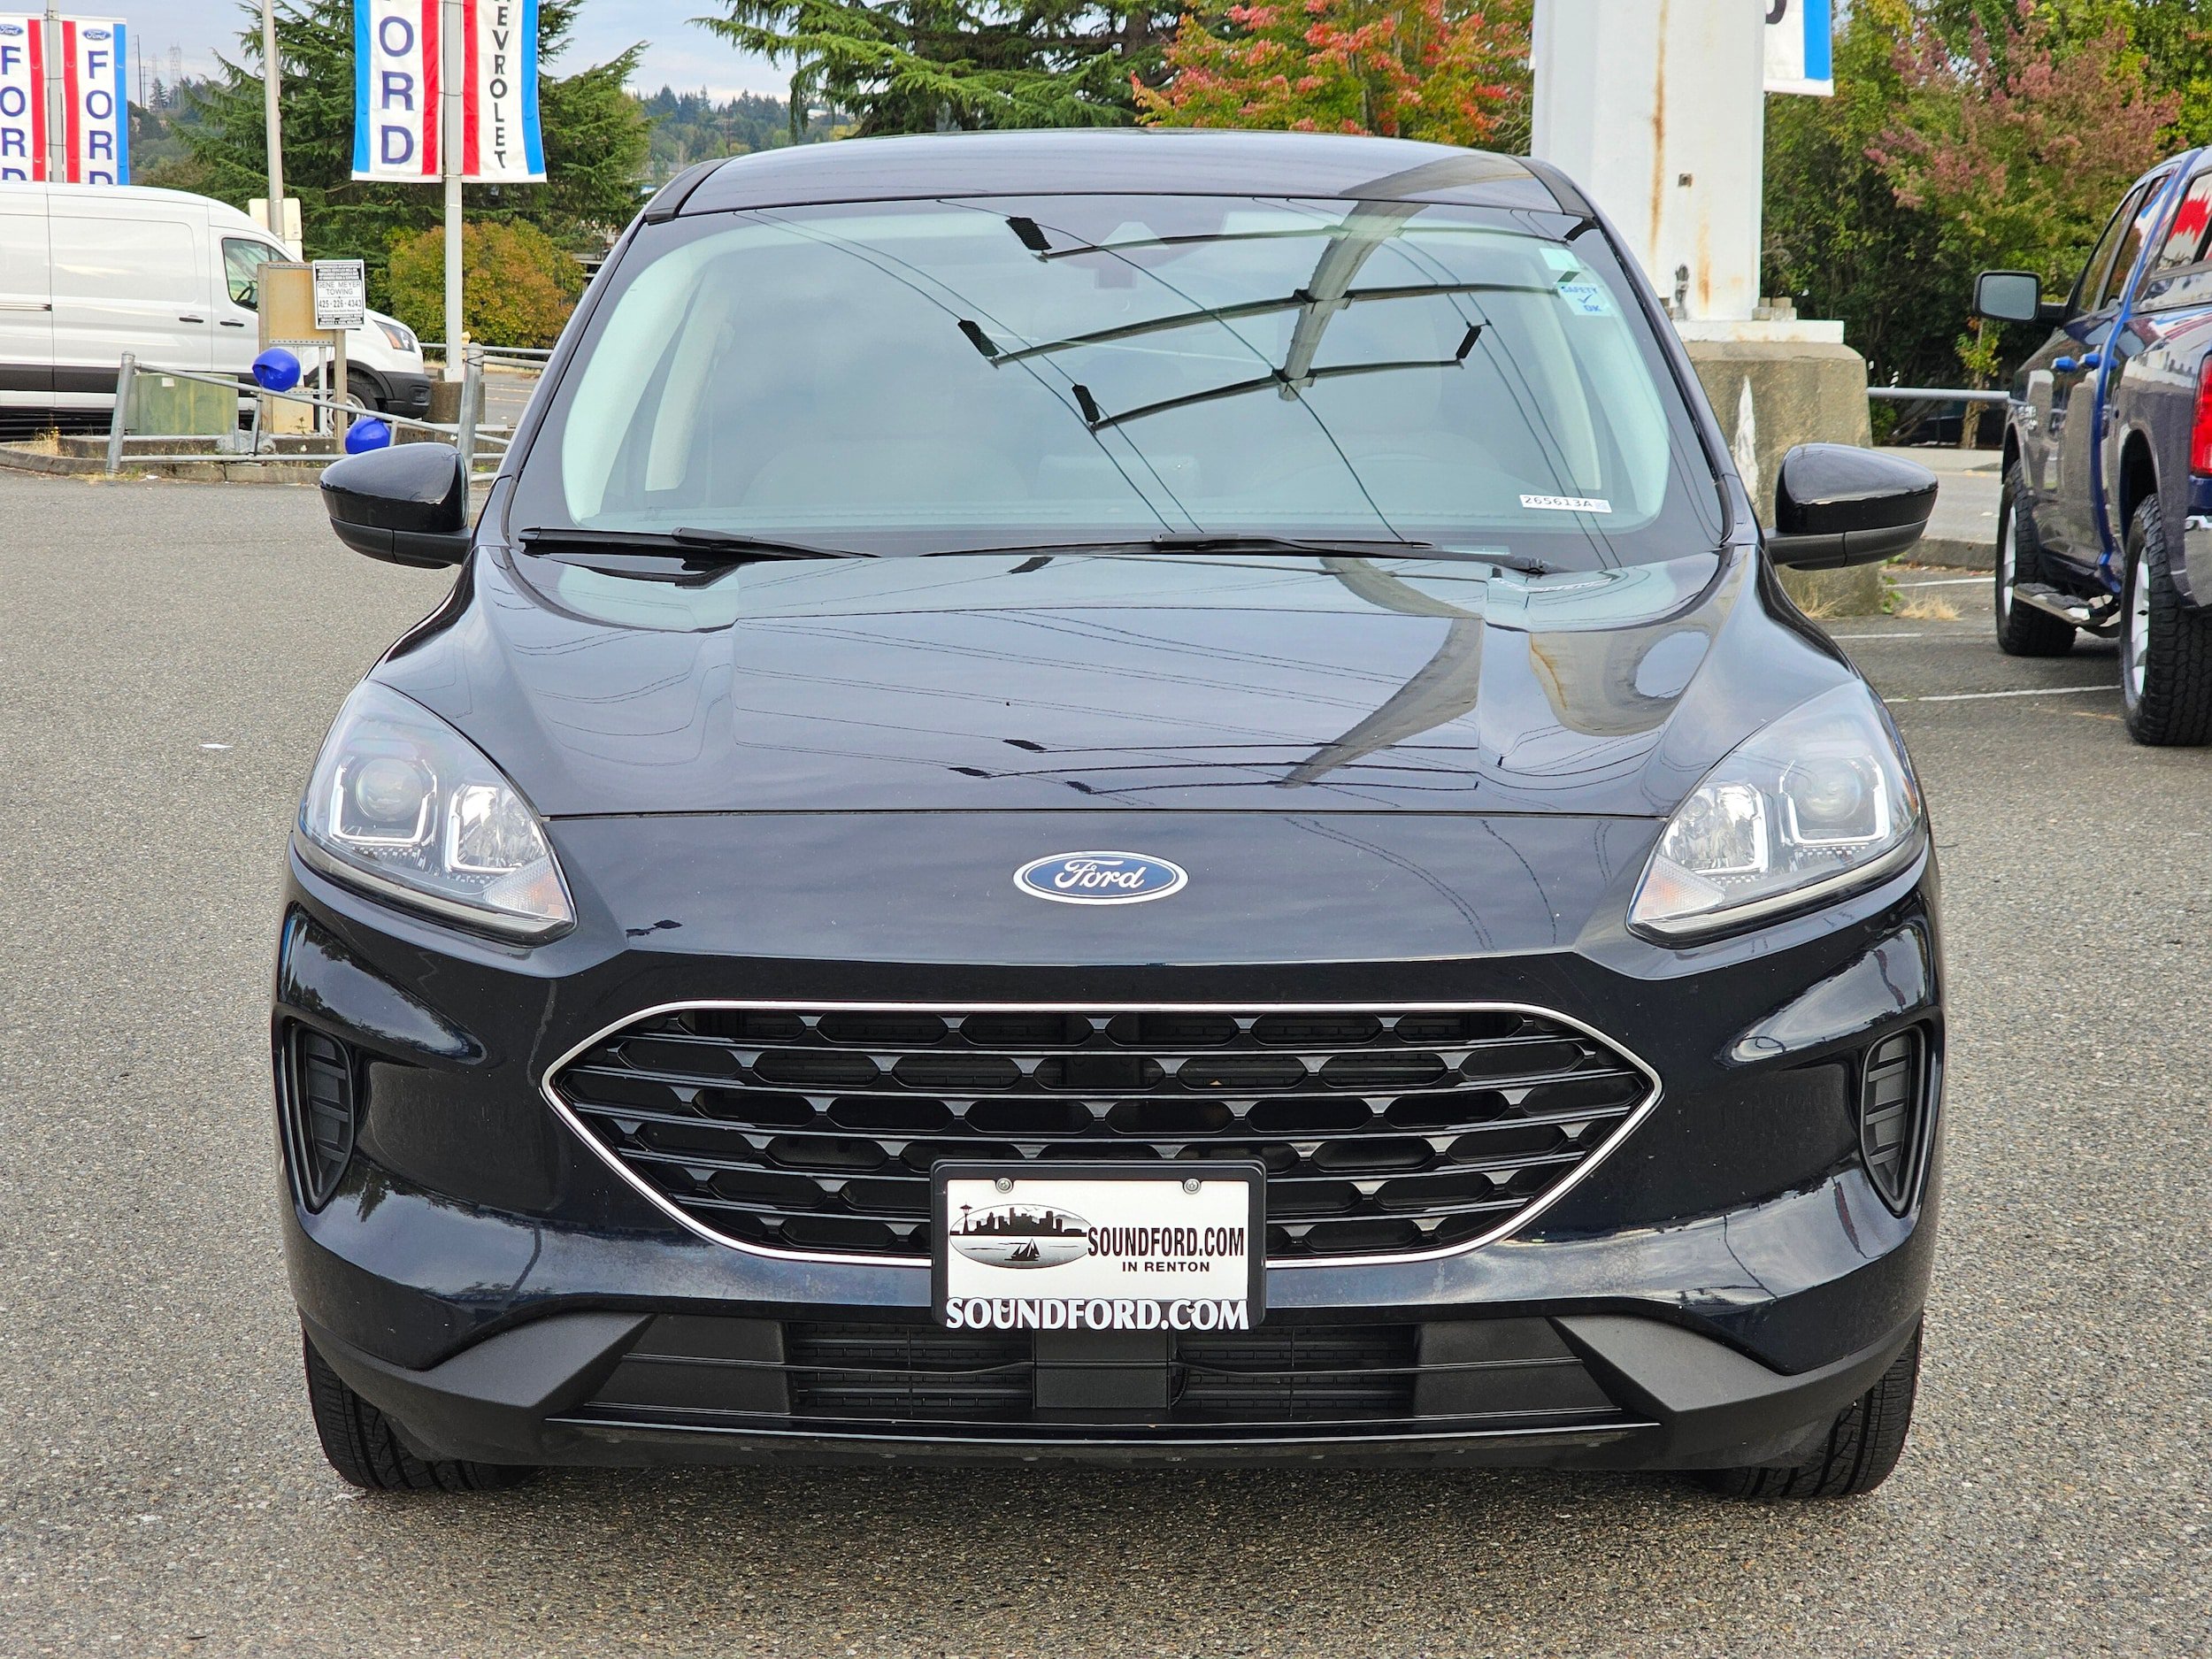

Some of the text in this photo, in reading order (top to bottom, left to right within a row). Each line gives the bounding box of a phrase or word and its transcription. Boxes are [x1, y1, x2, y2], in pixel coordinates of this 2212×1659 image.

[379, 0, 414, 165] ORD
[489, 0, 510, 169] EVROLET
[1523, 495, 1593, 507] 265613A
[1054, 858, 1147, 889] Ford
[1087, 1226, 1244, 1257] SOUNDFORD.COM
[1122, 1261, 1210, 1272] IN RENTON
[946, 1297, 1250, 1331] SOUNDFORD.COM
